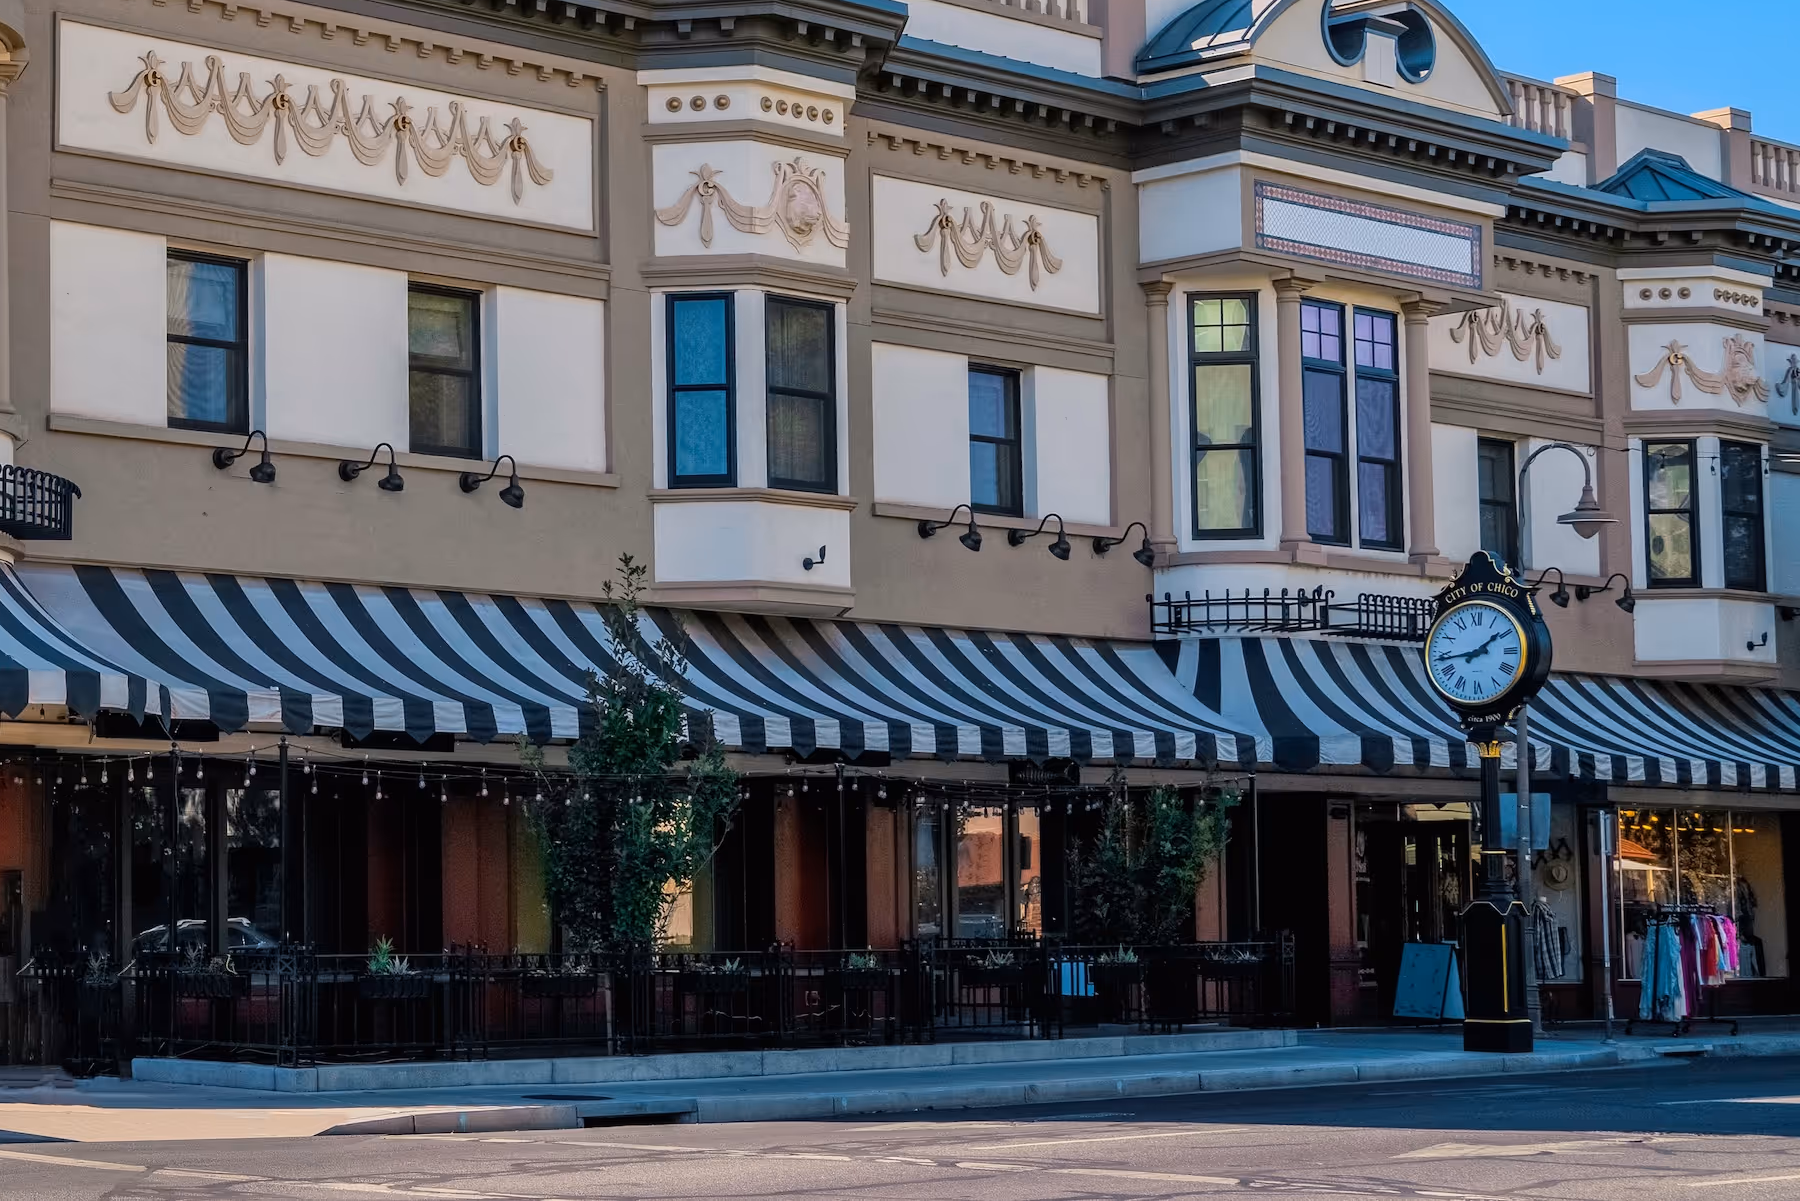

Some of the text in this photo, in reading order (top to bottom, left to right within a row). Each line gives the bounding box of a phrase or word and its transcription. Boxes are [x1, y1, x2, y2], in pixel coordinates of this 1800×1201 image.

[1445, 582, 1519, 604] CITY OF CHICO
[1470, 611, 1483, 627] XII
[1467, 712, 1502, 723] circa 1900
